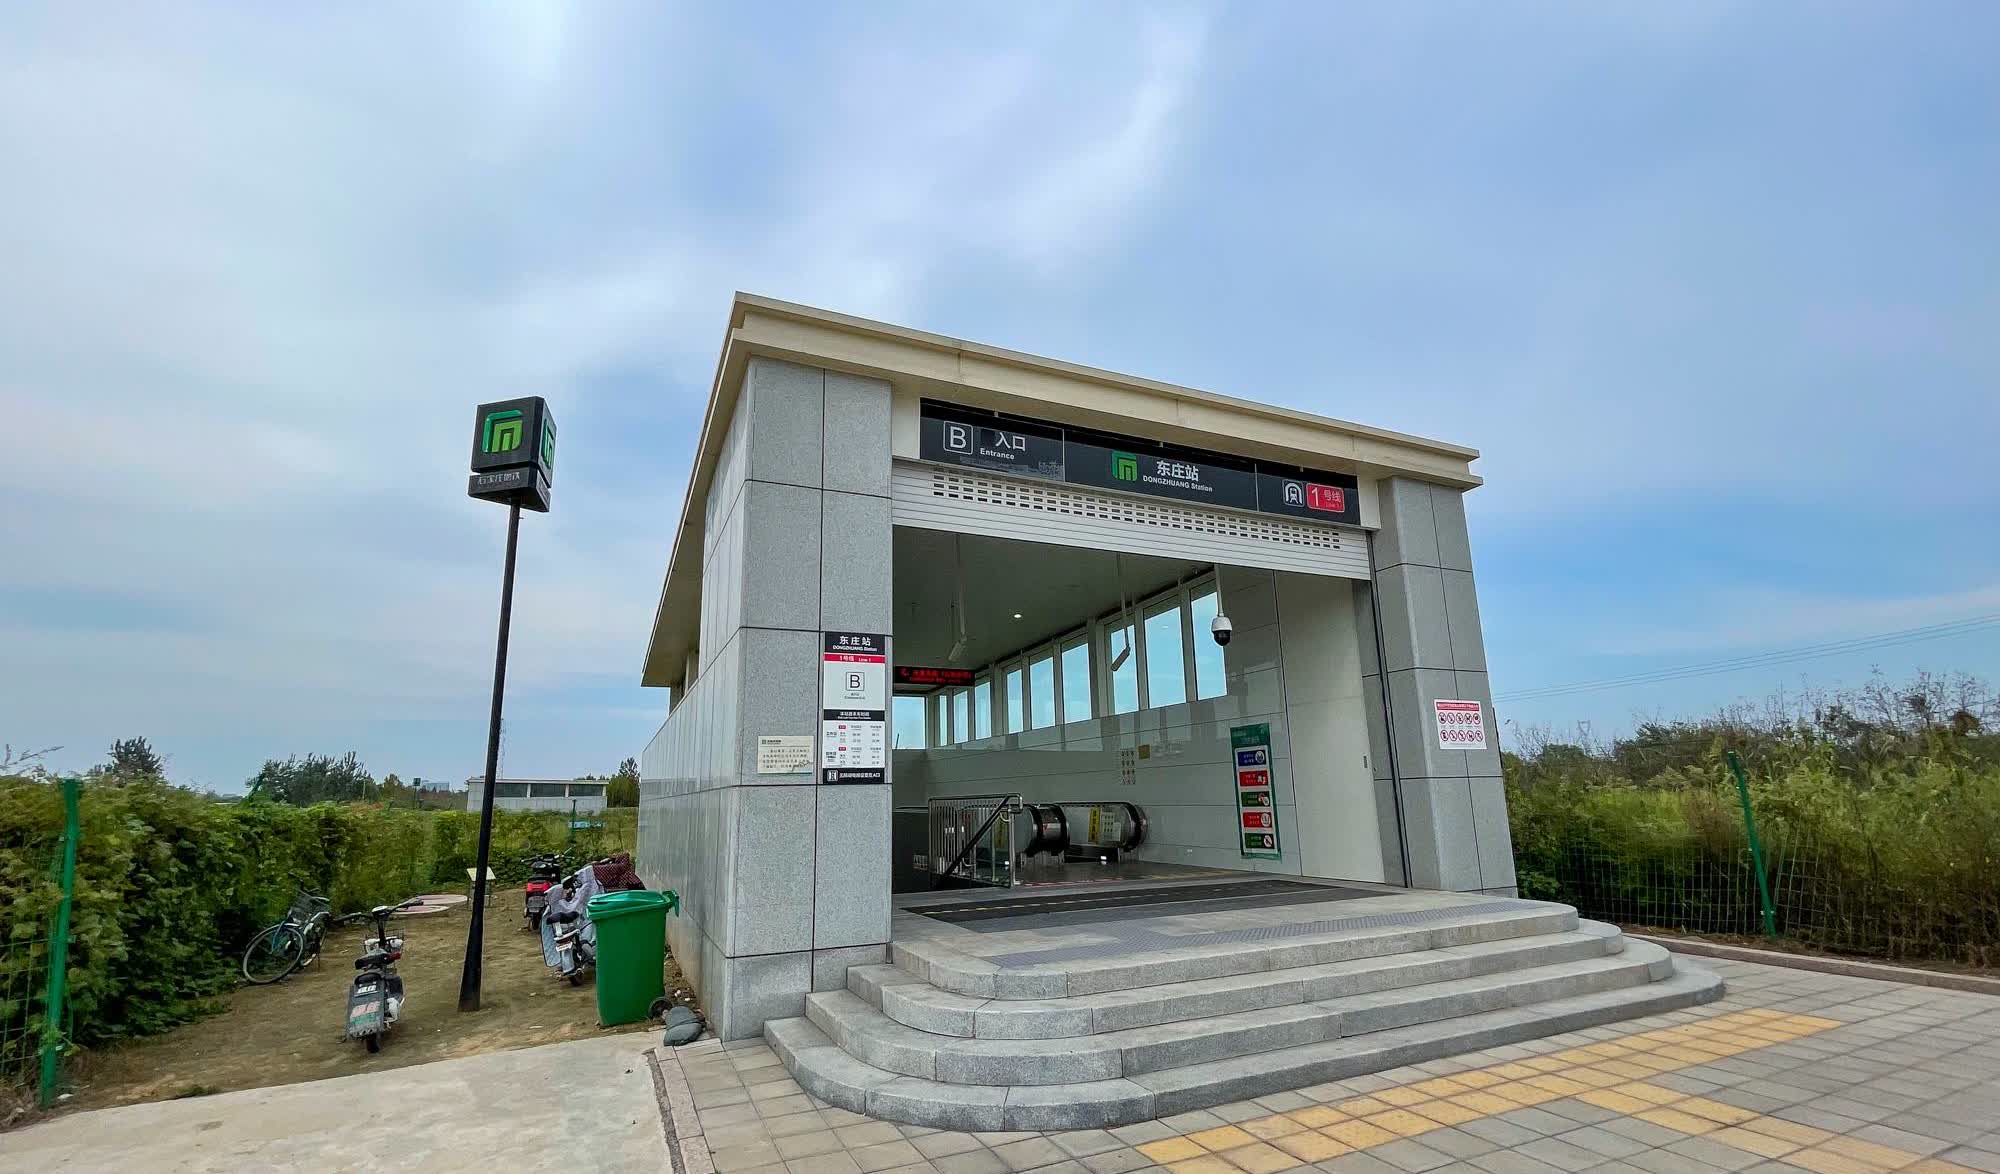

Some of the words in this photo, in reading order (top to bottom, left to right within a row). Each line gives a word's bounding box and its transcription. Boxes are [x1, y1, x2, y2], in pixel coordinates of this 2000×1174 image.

[950, 426, 967, 449] B
[995, 432, 1026, 452] 入口
[980, 447, 1015, 460] Entrance
[1156, 460, 1199, 482] 东庄站
[1142, 475, 1190, 489] DONGZHUANG
[1190, 482, 1213, 492] Station
[839, 635, 871, 646] 东庄站
[850, 674, 861, 689] B
